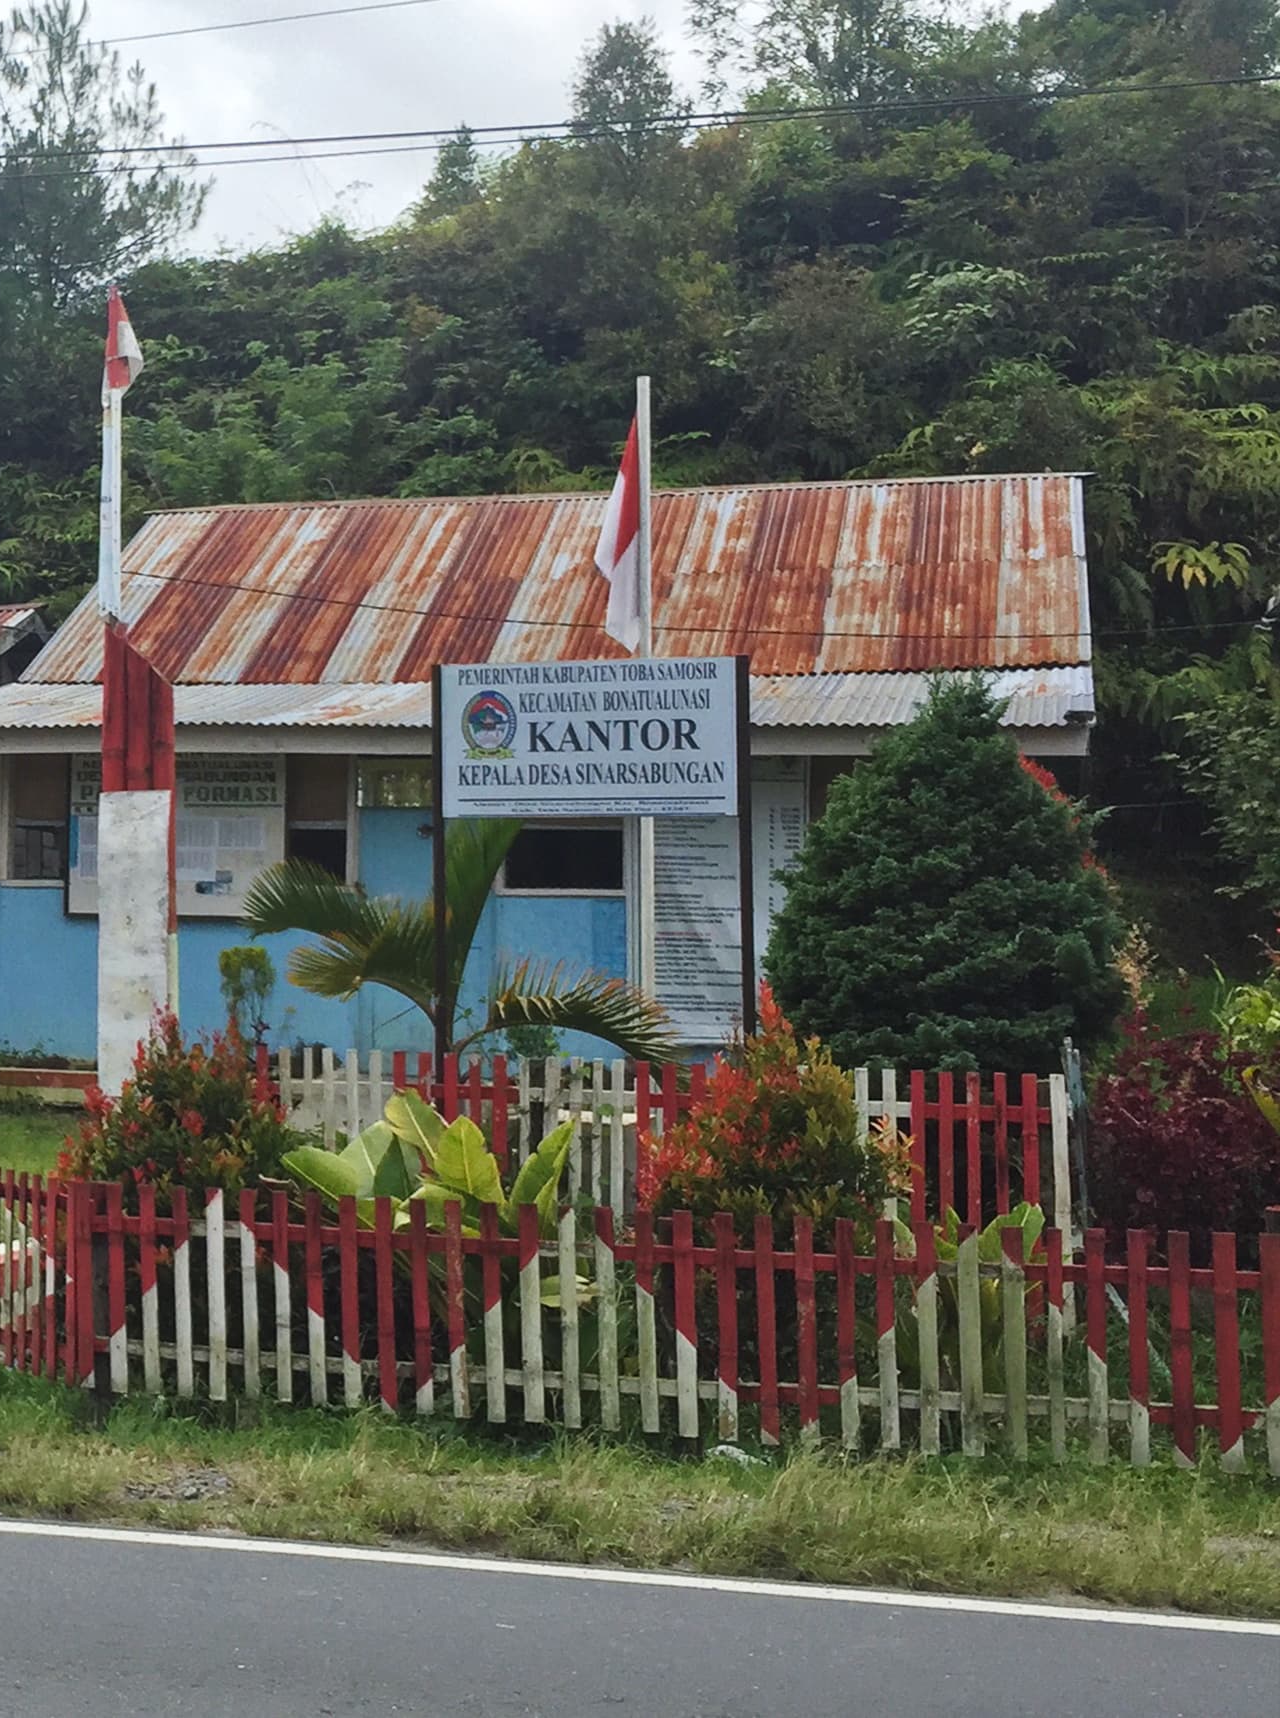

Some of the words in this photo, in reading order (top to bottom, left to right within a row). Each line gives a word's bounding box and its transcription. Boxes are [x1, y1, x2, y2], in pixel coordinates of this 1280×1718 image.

[458, 668, 539, 685] PEMERINTAH
[542, 664, 617, 683] KABUPATEN
[620, 664, 655, 682] TOBA
[657, 661, 718, 681] SAMOSIR
[519, 691, 597, 713] KECAMATAN
[603, 688, 710, 711] BONATUALUNASI
[528, 718, 700, 752] KANTOR
[458, 764, 525, 786] KEPALA
[528, 763, 572, 785] DESA
[575, 761, 724, 785] SINARSABUNGAN
[184, 786, 277, 802] FORMASI
